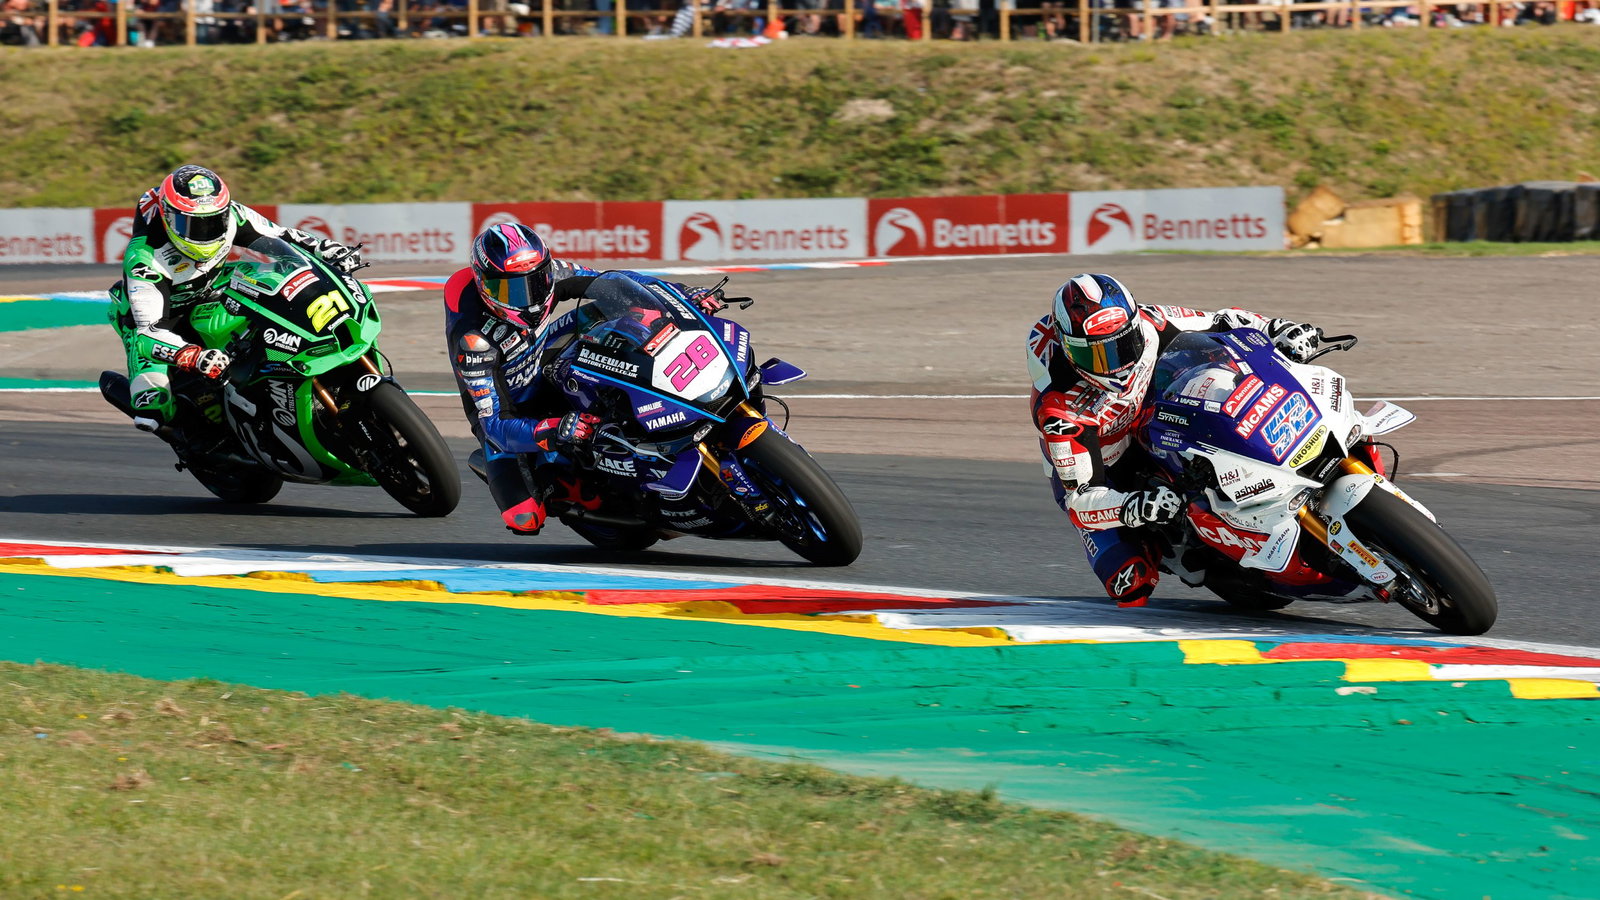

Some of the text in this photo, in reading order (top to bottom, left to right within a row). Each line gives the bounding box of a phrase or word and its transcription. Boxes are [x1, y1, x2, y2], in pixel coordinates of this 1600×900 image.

[534, 222, 650, 254] Bennetts
[729, 221, 851, 253] Bennetts
[932, 216, 1058, 249] Bennetts
[1142, 212, 1267, 241] Bennetts
[0, 231, 84, 259] ennetts
[343, 225, 455, 259] Bennetts
[306, 289, 350, 333] 21
[1086, 309, 1124, 328] LS2
[736, 331, 749, 362] YAMAHA
[579, 348, 640, 374] RACEWAYS
[663, 334, 720, 393] 28
[1234, 377, 1259, 401] Bennetts
[637, 400, 663, 415] YAMALUBE
[645, 411, 687, 431] YAMAHA
[1157, 411, 1190, 426] SYNTOL
[1236, 386, 1286, 437] McAMS
[1260, 391, 1323, 462] 52
[1292, 428, 1325, 466] BROSHUIS
[729, 462, 755, 493] PIRELLI
[1219, 468, 1240, 484] H&J
[1221, 477, 1241, 488] MARTIN
[1234, 477, 1272, 498] ashvale
[1079, 508, 1121, 524] McAMS
[1330, 521, 1342, 535] sbs
[1266, 527, 1290, 561] MAR-TRAIN
[1349, 542, 1376, 568] PIRELLI
